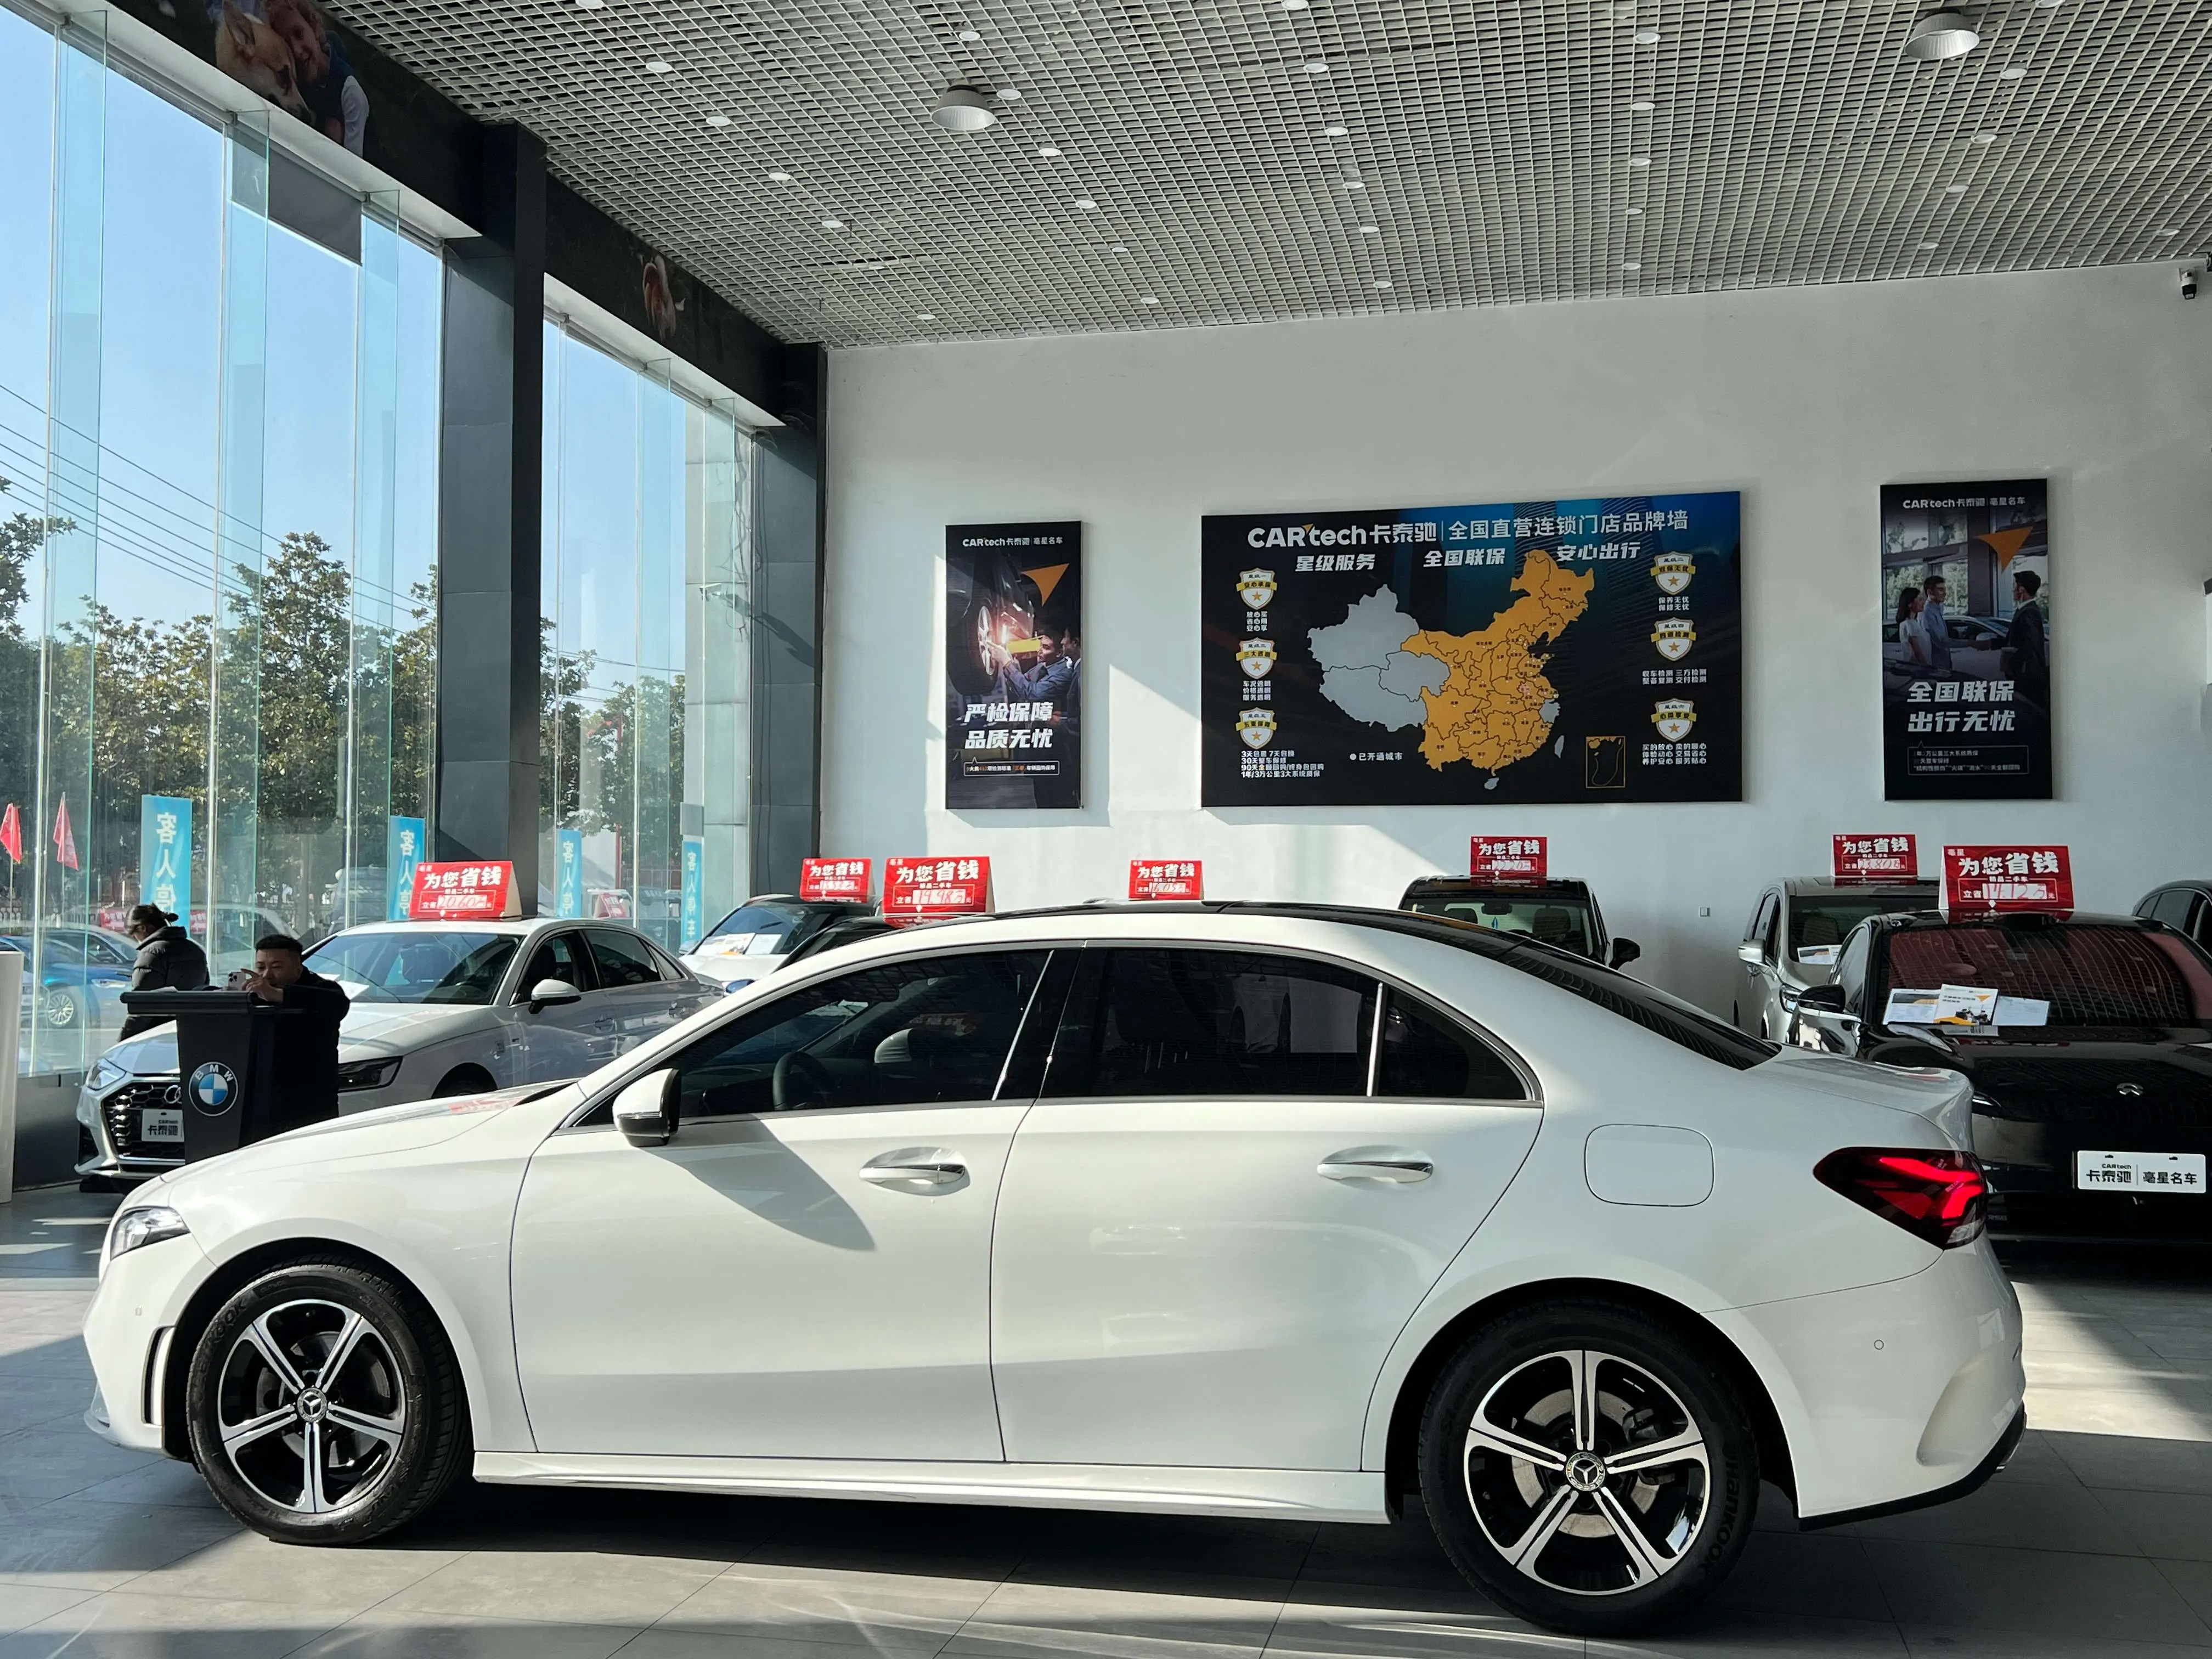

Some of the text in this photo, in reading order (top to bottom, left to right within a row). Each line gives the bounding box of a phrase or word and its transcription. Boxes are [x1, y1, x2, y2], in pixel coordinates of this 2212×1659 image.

[1248, 510, 1688, 548] CARtech 卡泰驰 全国直营连锁门店品牌墙
[963, 538, 1005, 547] CARtech
[1295, 542, 1641, 572] 星级服务 全国联保 安心出行
[1907, 680, 2015, 702] 全国联保
[964, 702, 1053, 722] 严检保障
[1908, 710, 2016, 732] 出行无忧
[964, 729, 1053, 749] 品质无忧
[1358, 752, 1403, 761] 已开通城市
[1479, 839, 1540, 855] 为您省钱
[1842, 837, 1909, 854] 为您省钱
[809, 861, 864, 877] 为您省钱
[895, 859, 979, 884] 为您省钱
[1137, 862, 1194, 878] 为您省钱
[1959, 851, 2059, 877] 为您省钱
[423, 866, 502, 889] 为您省钱
[195, 1064, 234, 1081] BMW
[2086, 1170, 2131, 1183] 卡泰驰
